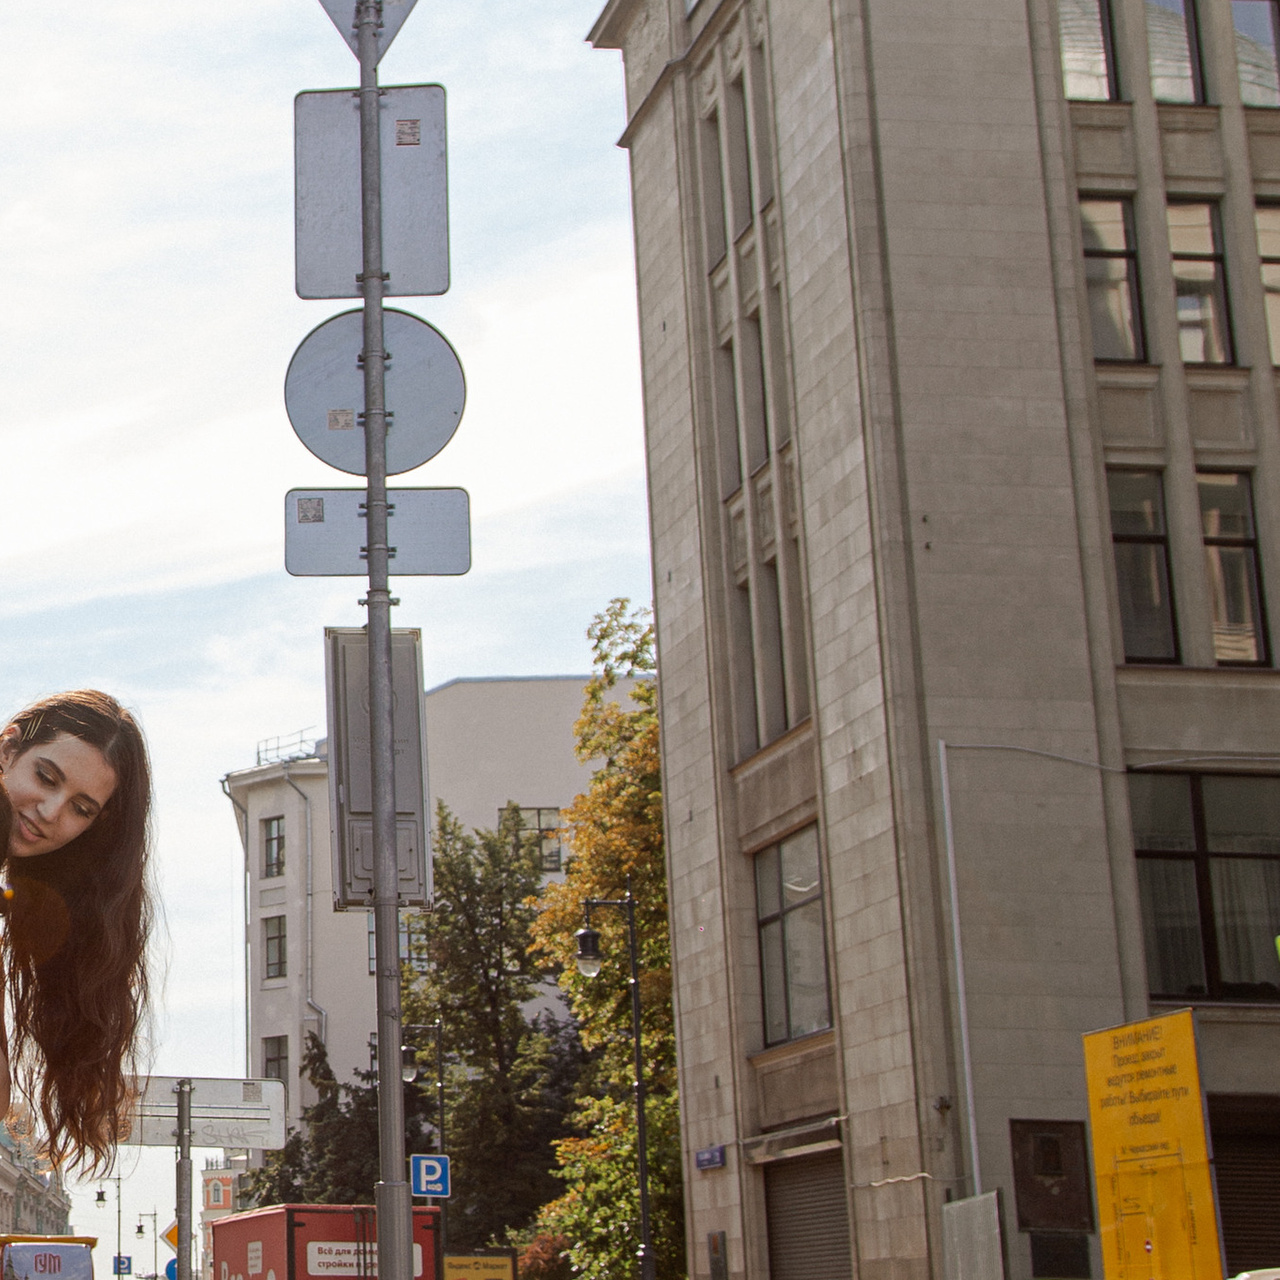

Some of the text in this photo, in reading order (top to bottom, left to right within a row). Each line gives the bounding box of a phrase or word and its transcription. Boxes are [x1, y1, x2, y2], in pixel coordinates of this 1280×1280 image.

[1112, 1025, 1163, 1050] ВНИМАНИЕ!
[420, 1159, 442, 1192] P
[317, 1246, 333, 1255] Всё
[335, 1248, 351, 1256] для
[317, 1259, 354, 1270] стройки
